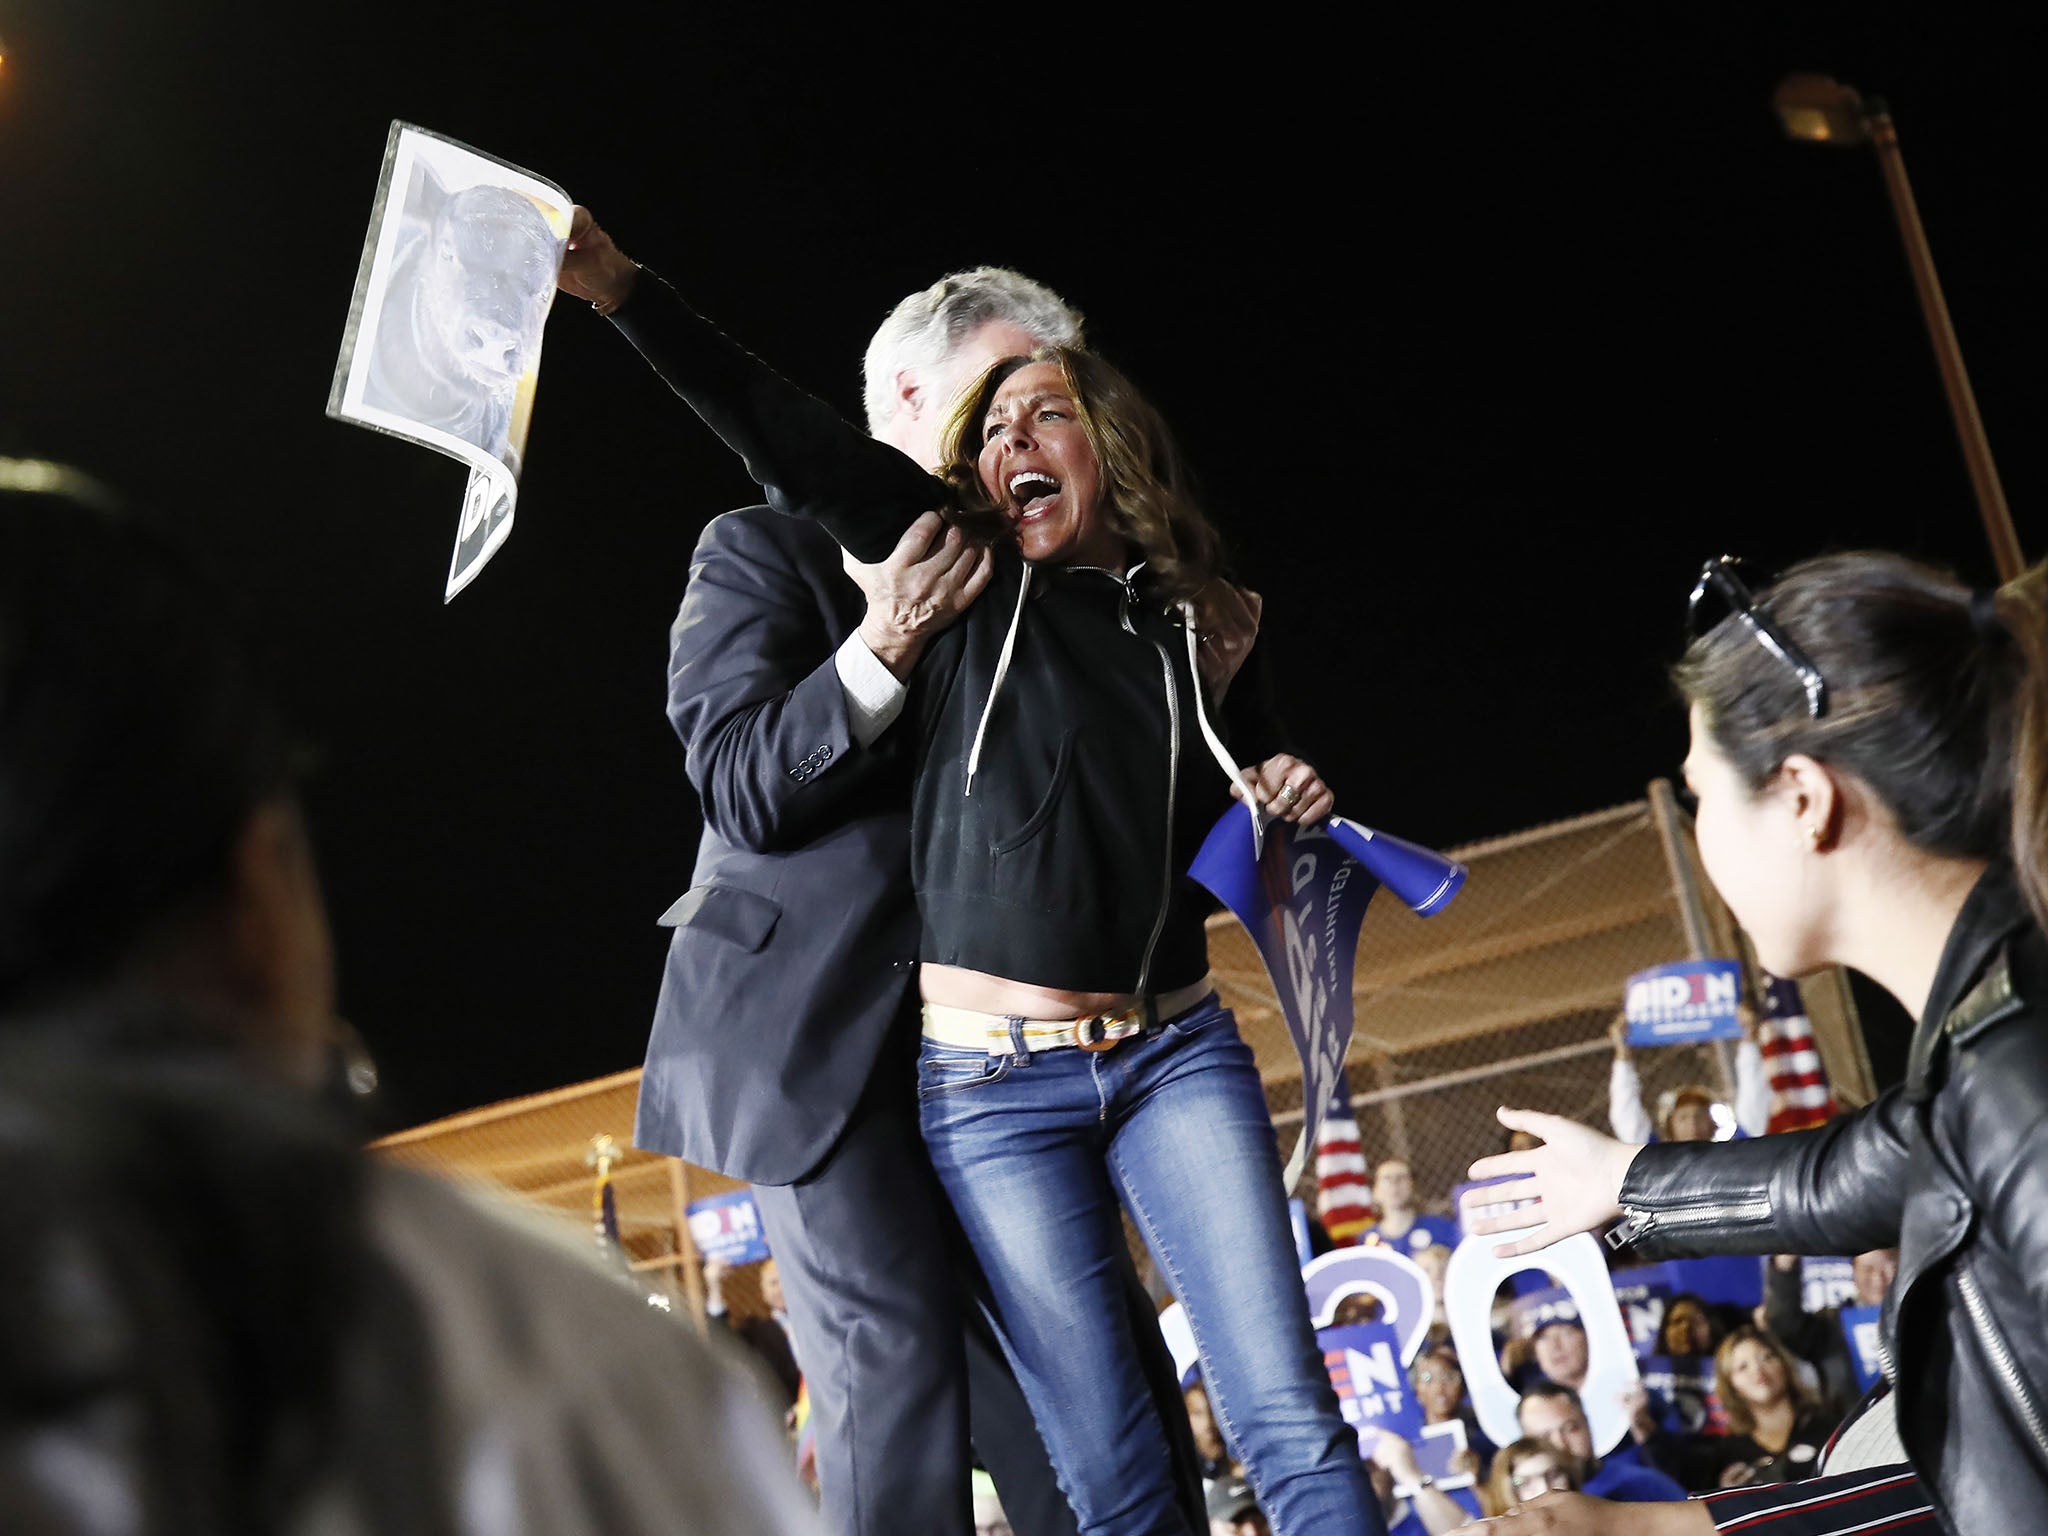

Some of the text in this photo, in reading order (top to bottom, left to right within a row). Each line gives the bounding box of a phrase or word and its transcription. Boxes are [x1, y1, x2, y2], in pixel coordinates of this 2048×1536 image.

[1326, 867, 1352, 946] UNITED
[1323, 1342, 1400, 1397] EN
[1340, 1391, 1402, 1422] ENT
